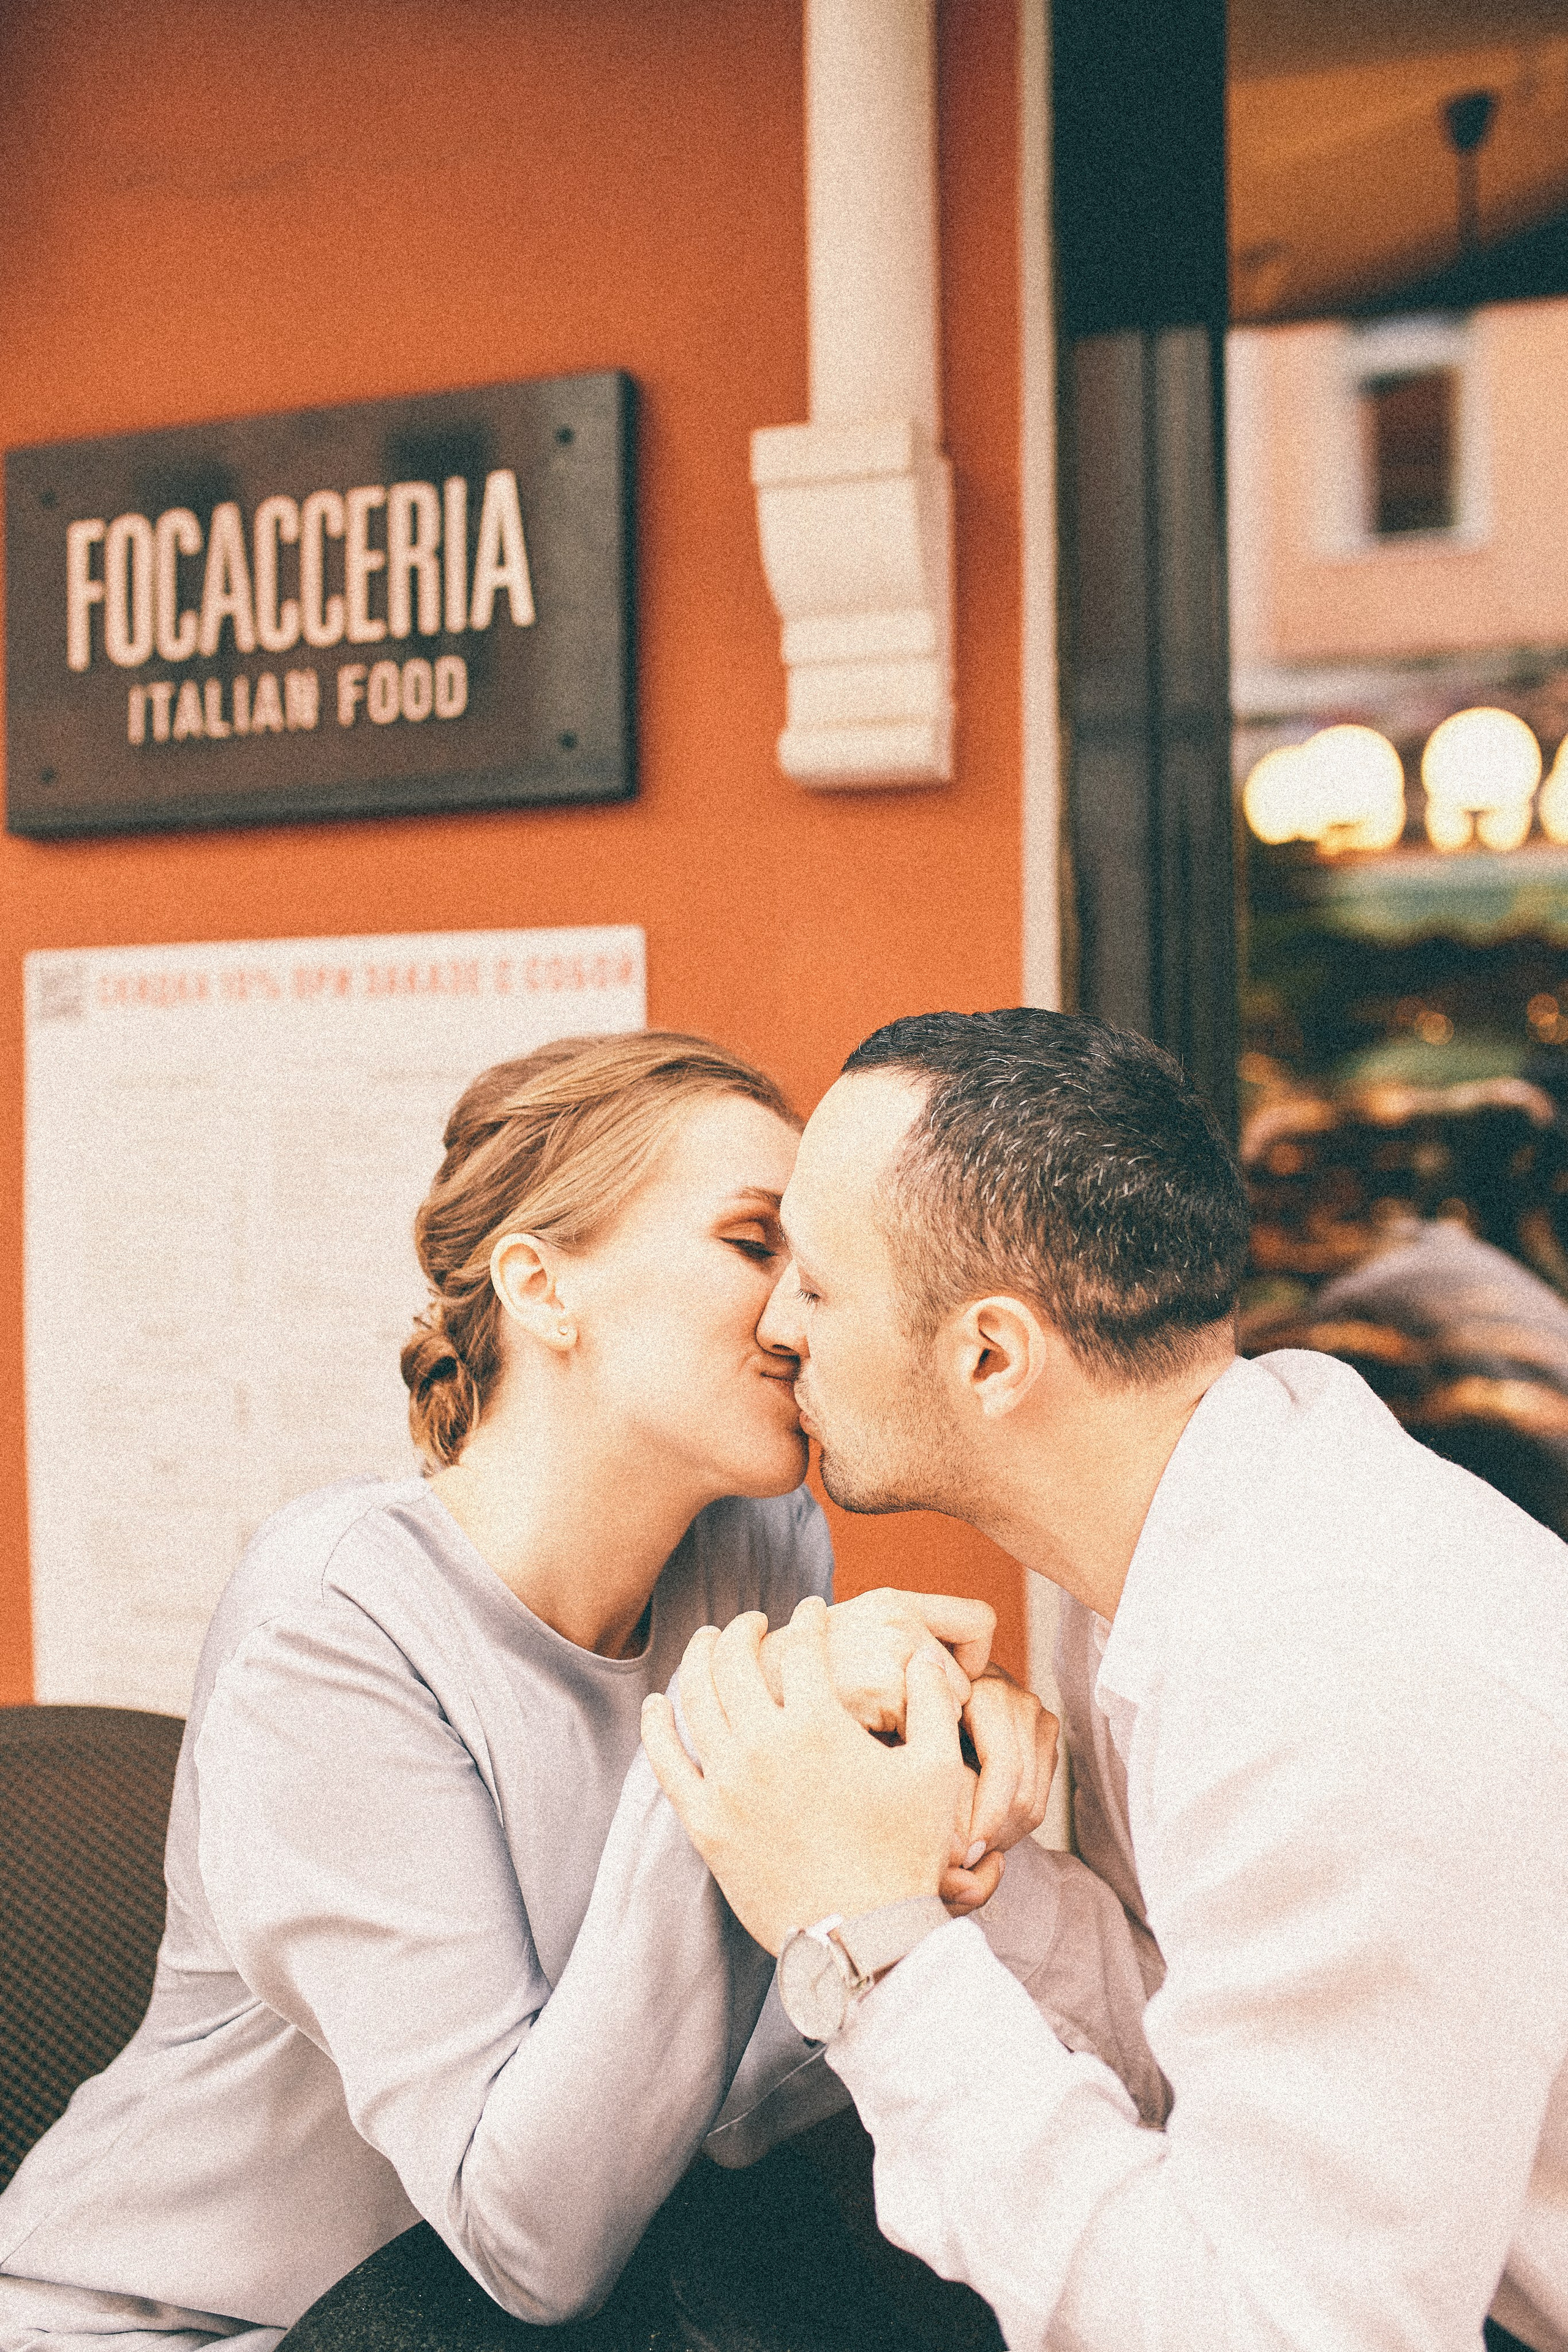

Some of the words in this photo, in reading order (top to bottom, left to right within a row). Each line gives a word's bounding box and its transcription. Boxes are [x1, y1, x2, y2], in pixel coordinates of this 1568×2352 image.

[66, 469, 535, 671] FOCACCERIA
[127, 668, 320, 745] ITALIAN
[337, 655, 469, 728] FOOD
[292, 963, 352, 1000] ПРИ
